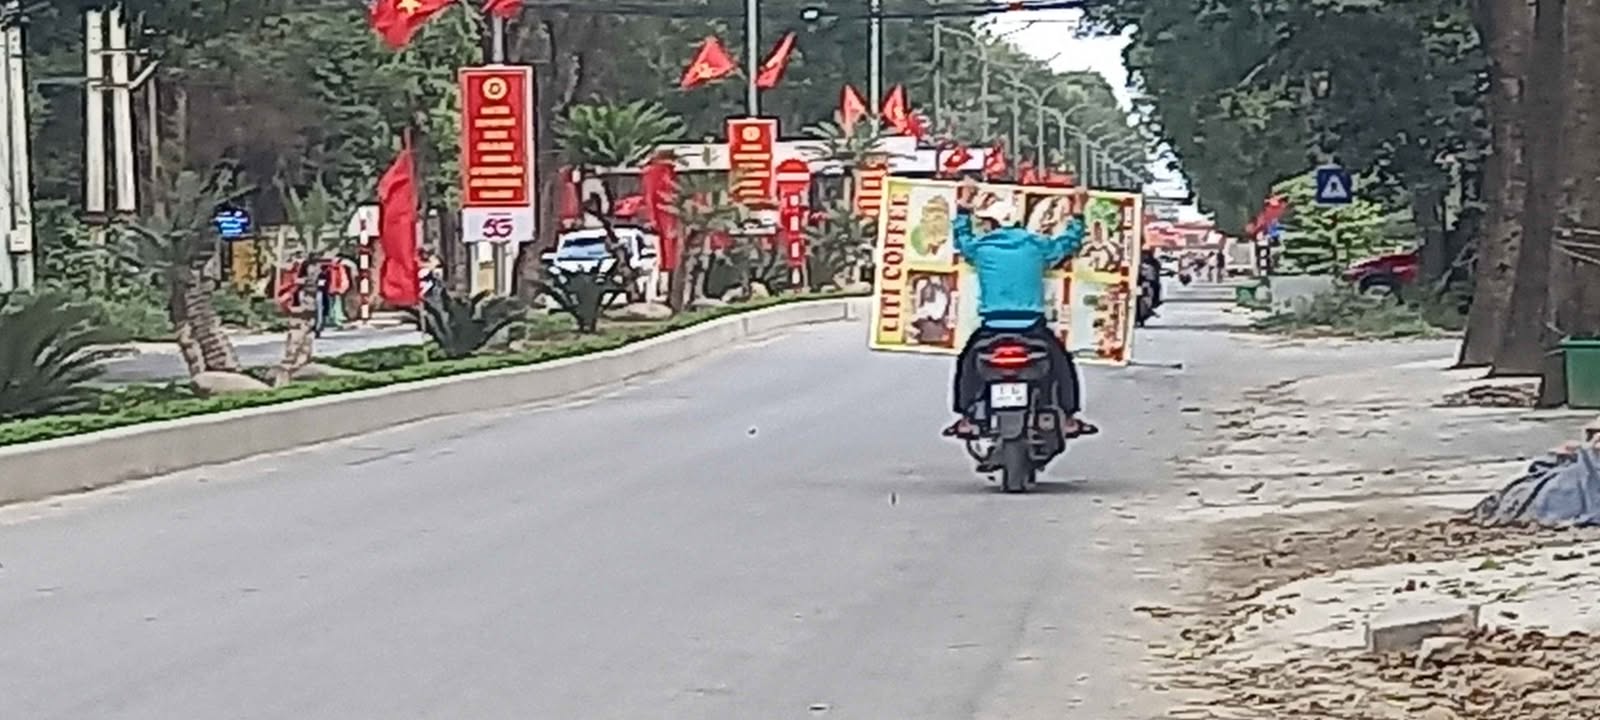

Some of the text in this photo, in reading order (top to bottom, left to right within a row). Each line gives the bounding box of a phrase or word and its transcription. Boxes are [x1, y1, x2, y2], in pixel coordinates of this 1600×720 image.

[482, 218, 513, 238] 5G
[882, 193, 910, 332] LITI COFFEE
